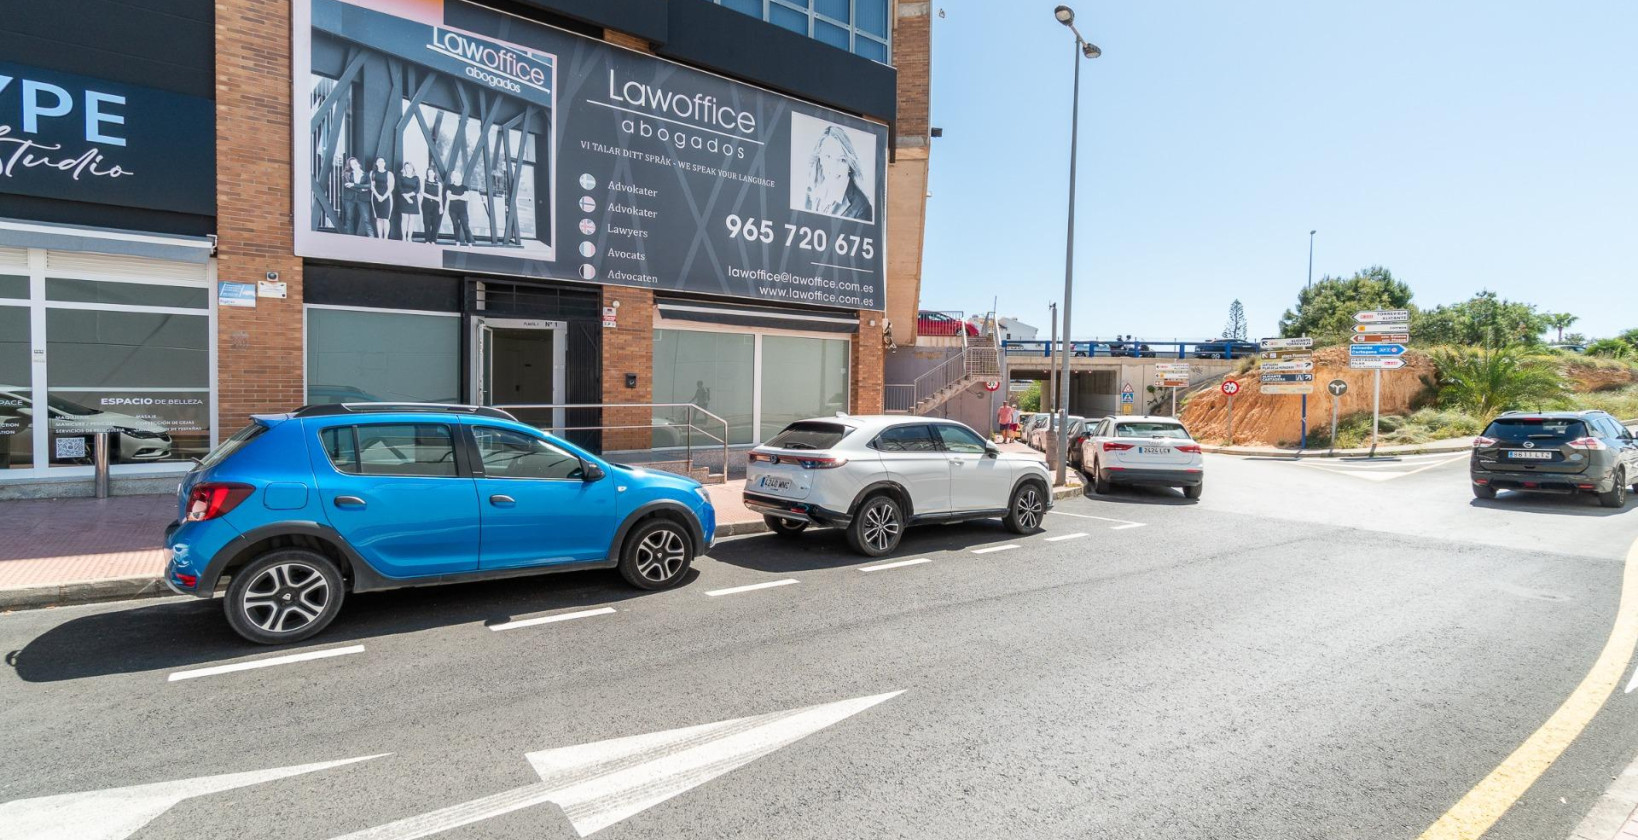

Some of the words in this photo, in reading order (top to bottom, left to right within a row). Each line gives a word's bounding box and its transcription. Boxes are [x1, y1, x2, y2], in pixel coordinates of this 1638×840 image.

[433, 26, 545, 86] Lawoffice
[465, 66, 521, 93] abogados
[609, 69, 756, 134] Lawoffice
[621, 119, 745, 159] abogados
[580, 140, 590, 150] VI
[591, 142, 621, 157] TALAR
[622, 149, 643, 161] DITT
[644, 153, 671, 166] SPRÅK
[677, 160, 691, 171] WE
[692, 164, 717, 176] SPEAK
[717, 168, 738, 180] YOUR
[738, 173, 776, 188] LANGUAGE
[607, 180, 658, 197] Advokater
[607, 202, 658, 219] Advokater
[607, 223, 648, 238] Lawyers
[725, 214, 774, 244] 965
[784, 223, 827, 252] 720
[834, 233, 874, 260] 675
[607, 247, 646, 261] Avocats
[607, 269, 658, 283] Advocaten
[728, 265, 874, 294] lawoffice@lawoffice.com.es
[759, 285, 874, 307] www.lawoffice.com.es
[101, 397, 153, 405] ESPACIO
